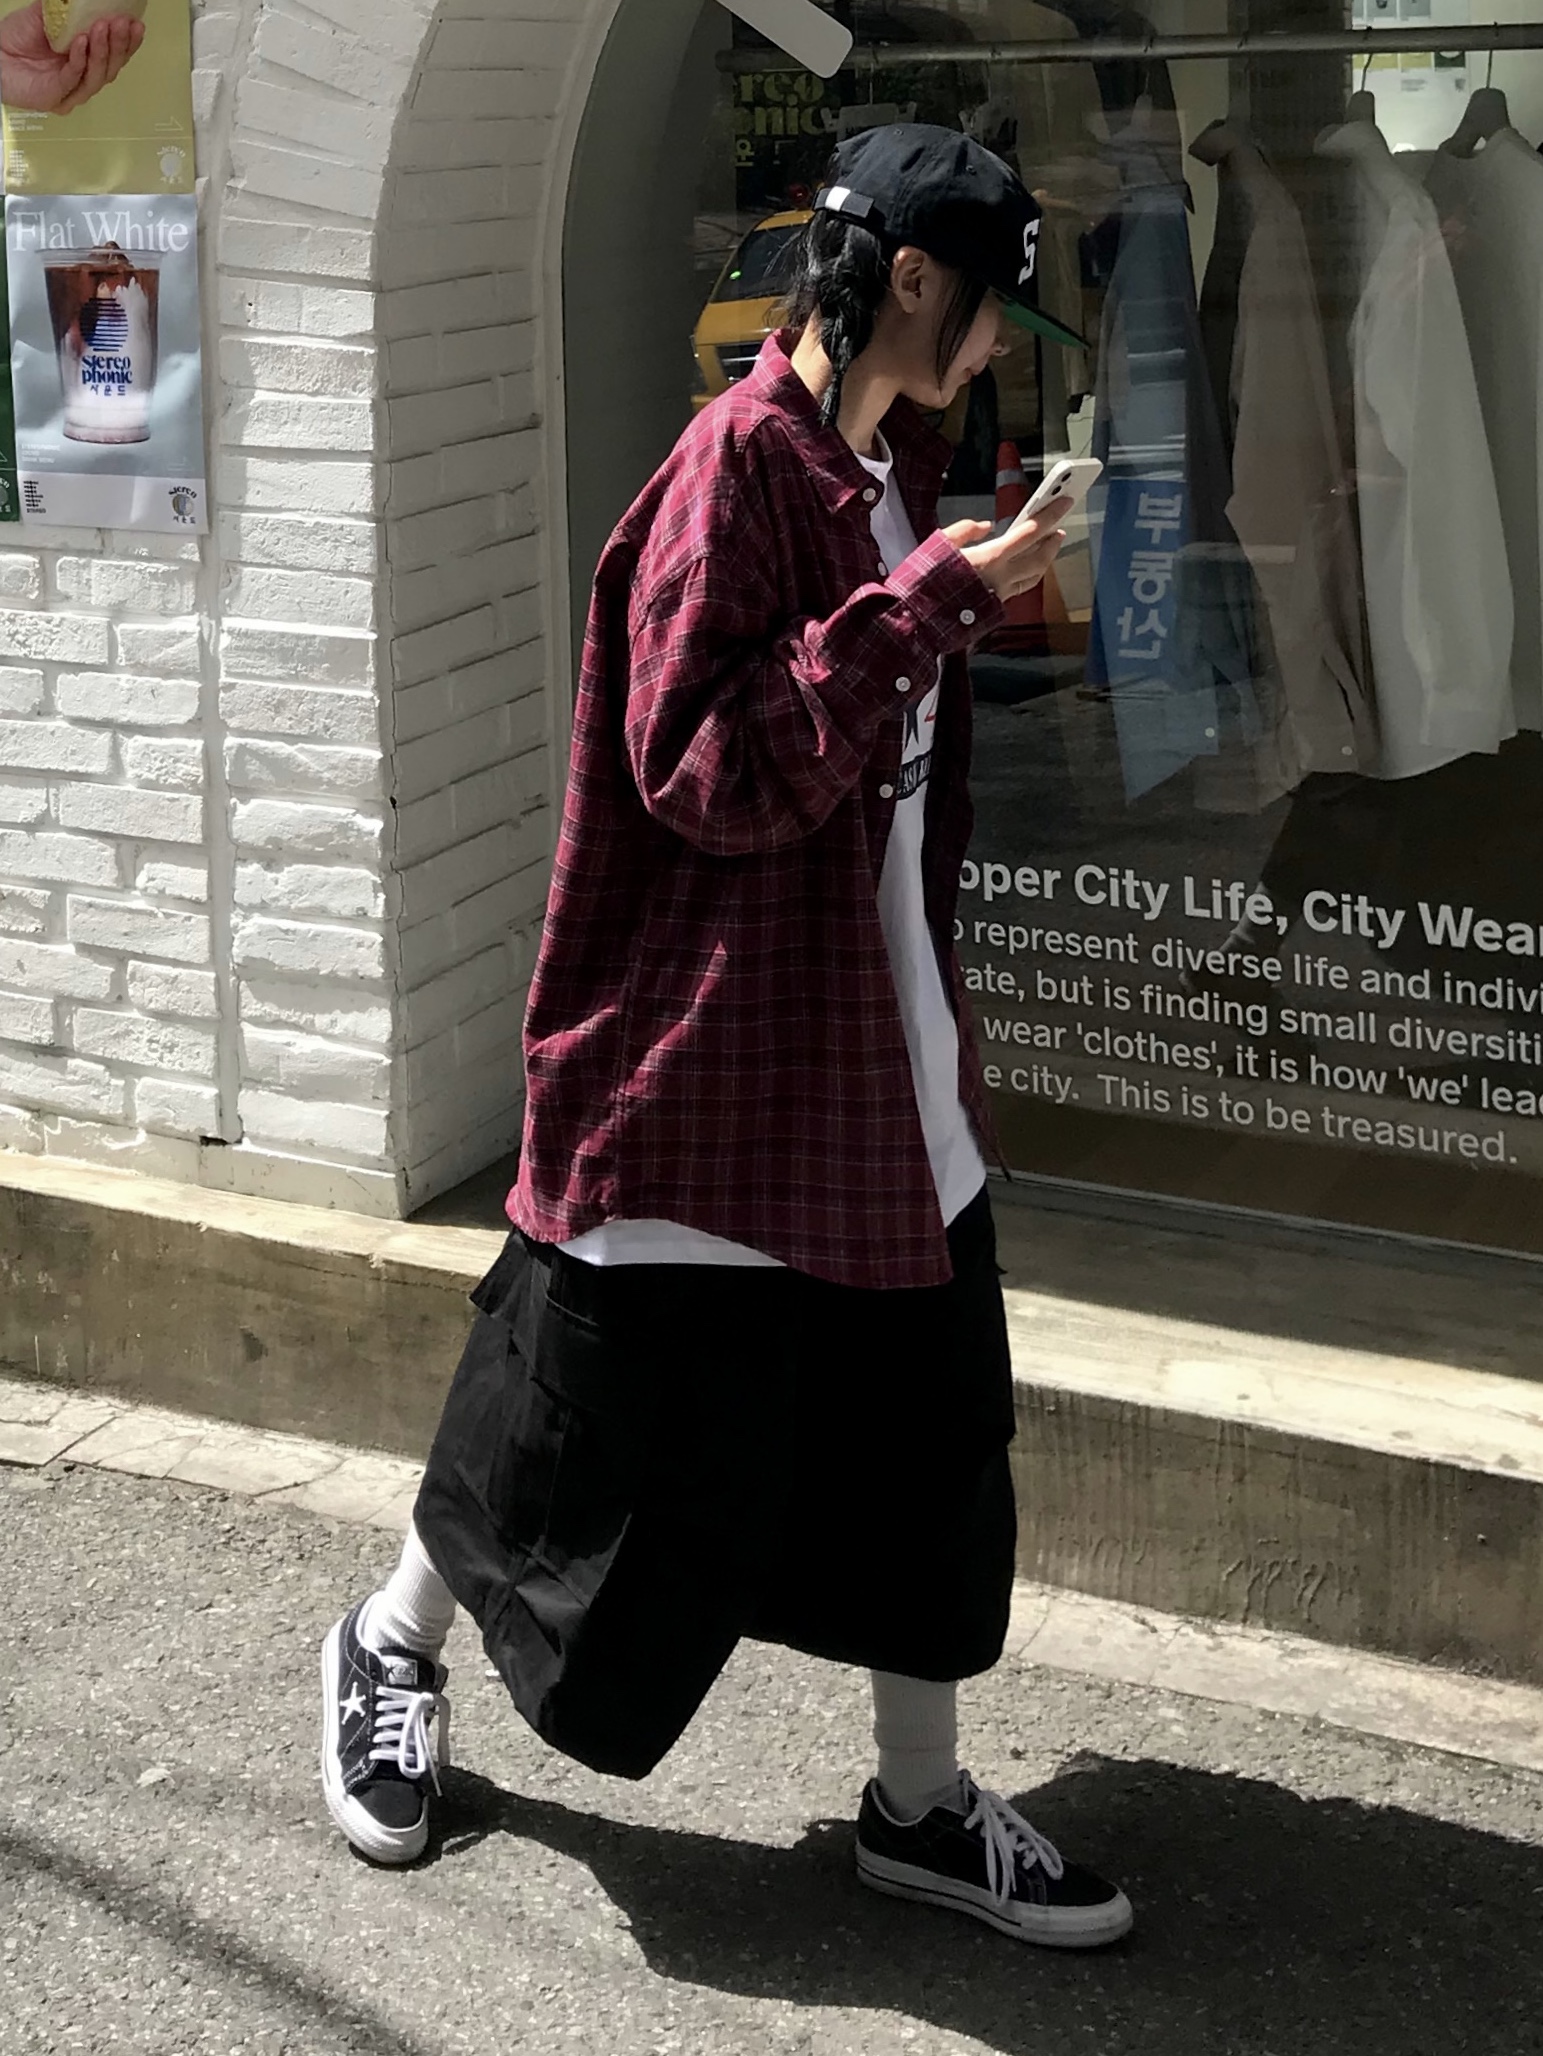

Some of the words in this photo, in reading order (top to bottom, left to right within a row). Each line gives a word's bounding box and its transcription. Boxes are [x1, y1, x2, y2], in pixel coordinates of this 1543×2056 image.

[12, 211, 75, 250] Flat
[82, 210, 189, 251] White
[1074, 864, 1169, 921] City
[1184, 875, 1288, 936] Life,
[1303, 890, 1406, 948] City
[975, 921, 1138, 963] represent
[1152, 937, 1283, 981] diverse
[1294, 953, 1349, 989] life
[1361, 969, 1431, 1001] and
[960, 962, 1025, 1002] ate,
[1037, 969, 1093, 1005] but
[1104, 977, 1131, 1010] is
[1140, 983, 1268, 1035] finding
[1280, 1008, 1376, 1043] small
[983, 1016, 1066, 1048] wear
[1077, 1022, 1224, 1078] 'clothes',
[1236, 1044, 1259, 1076] it
[1270, 1048, 1299, 1082] is
[1311, 1054, 1387, 1094] how
[1399, 1065, 1469, 1104] 'we'
[1011, 1064, 1080, 1103] city.
[1097, 1073, 1171, 1112] This
[1182, 1085, 1210, 1118] is
[1219, 1091, 1255, 1124] to
[1267, 1098, 1311, 1133] be
[1321, 1106, 1517, 1163] treasured.
